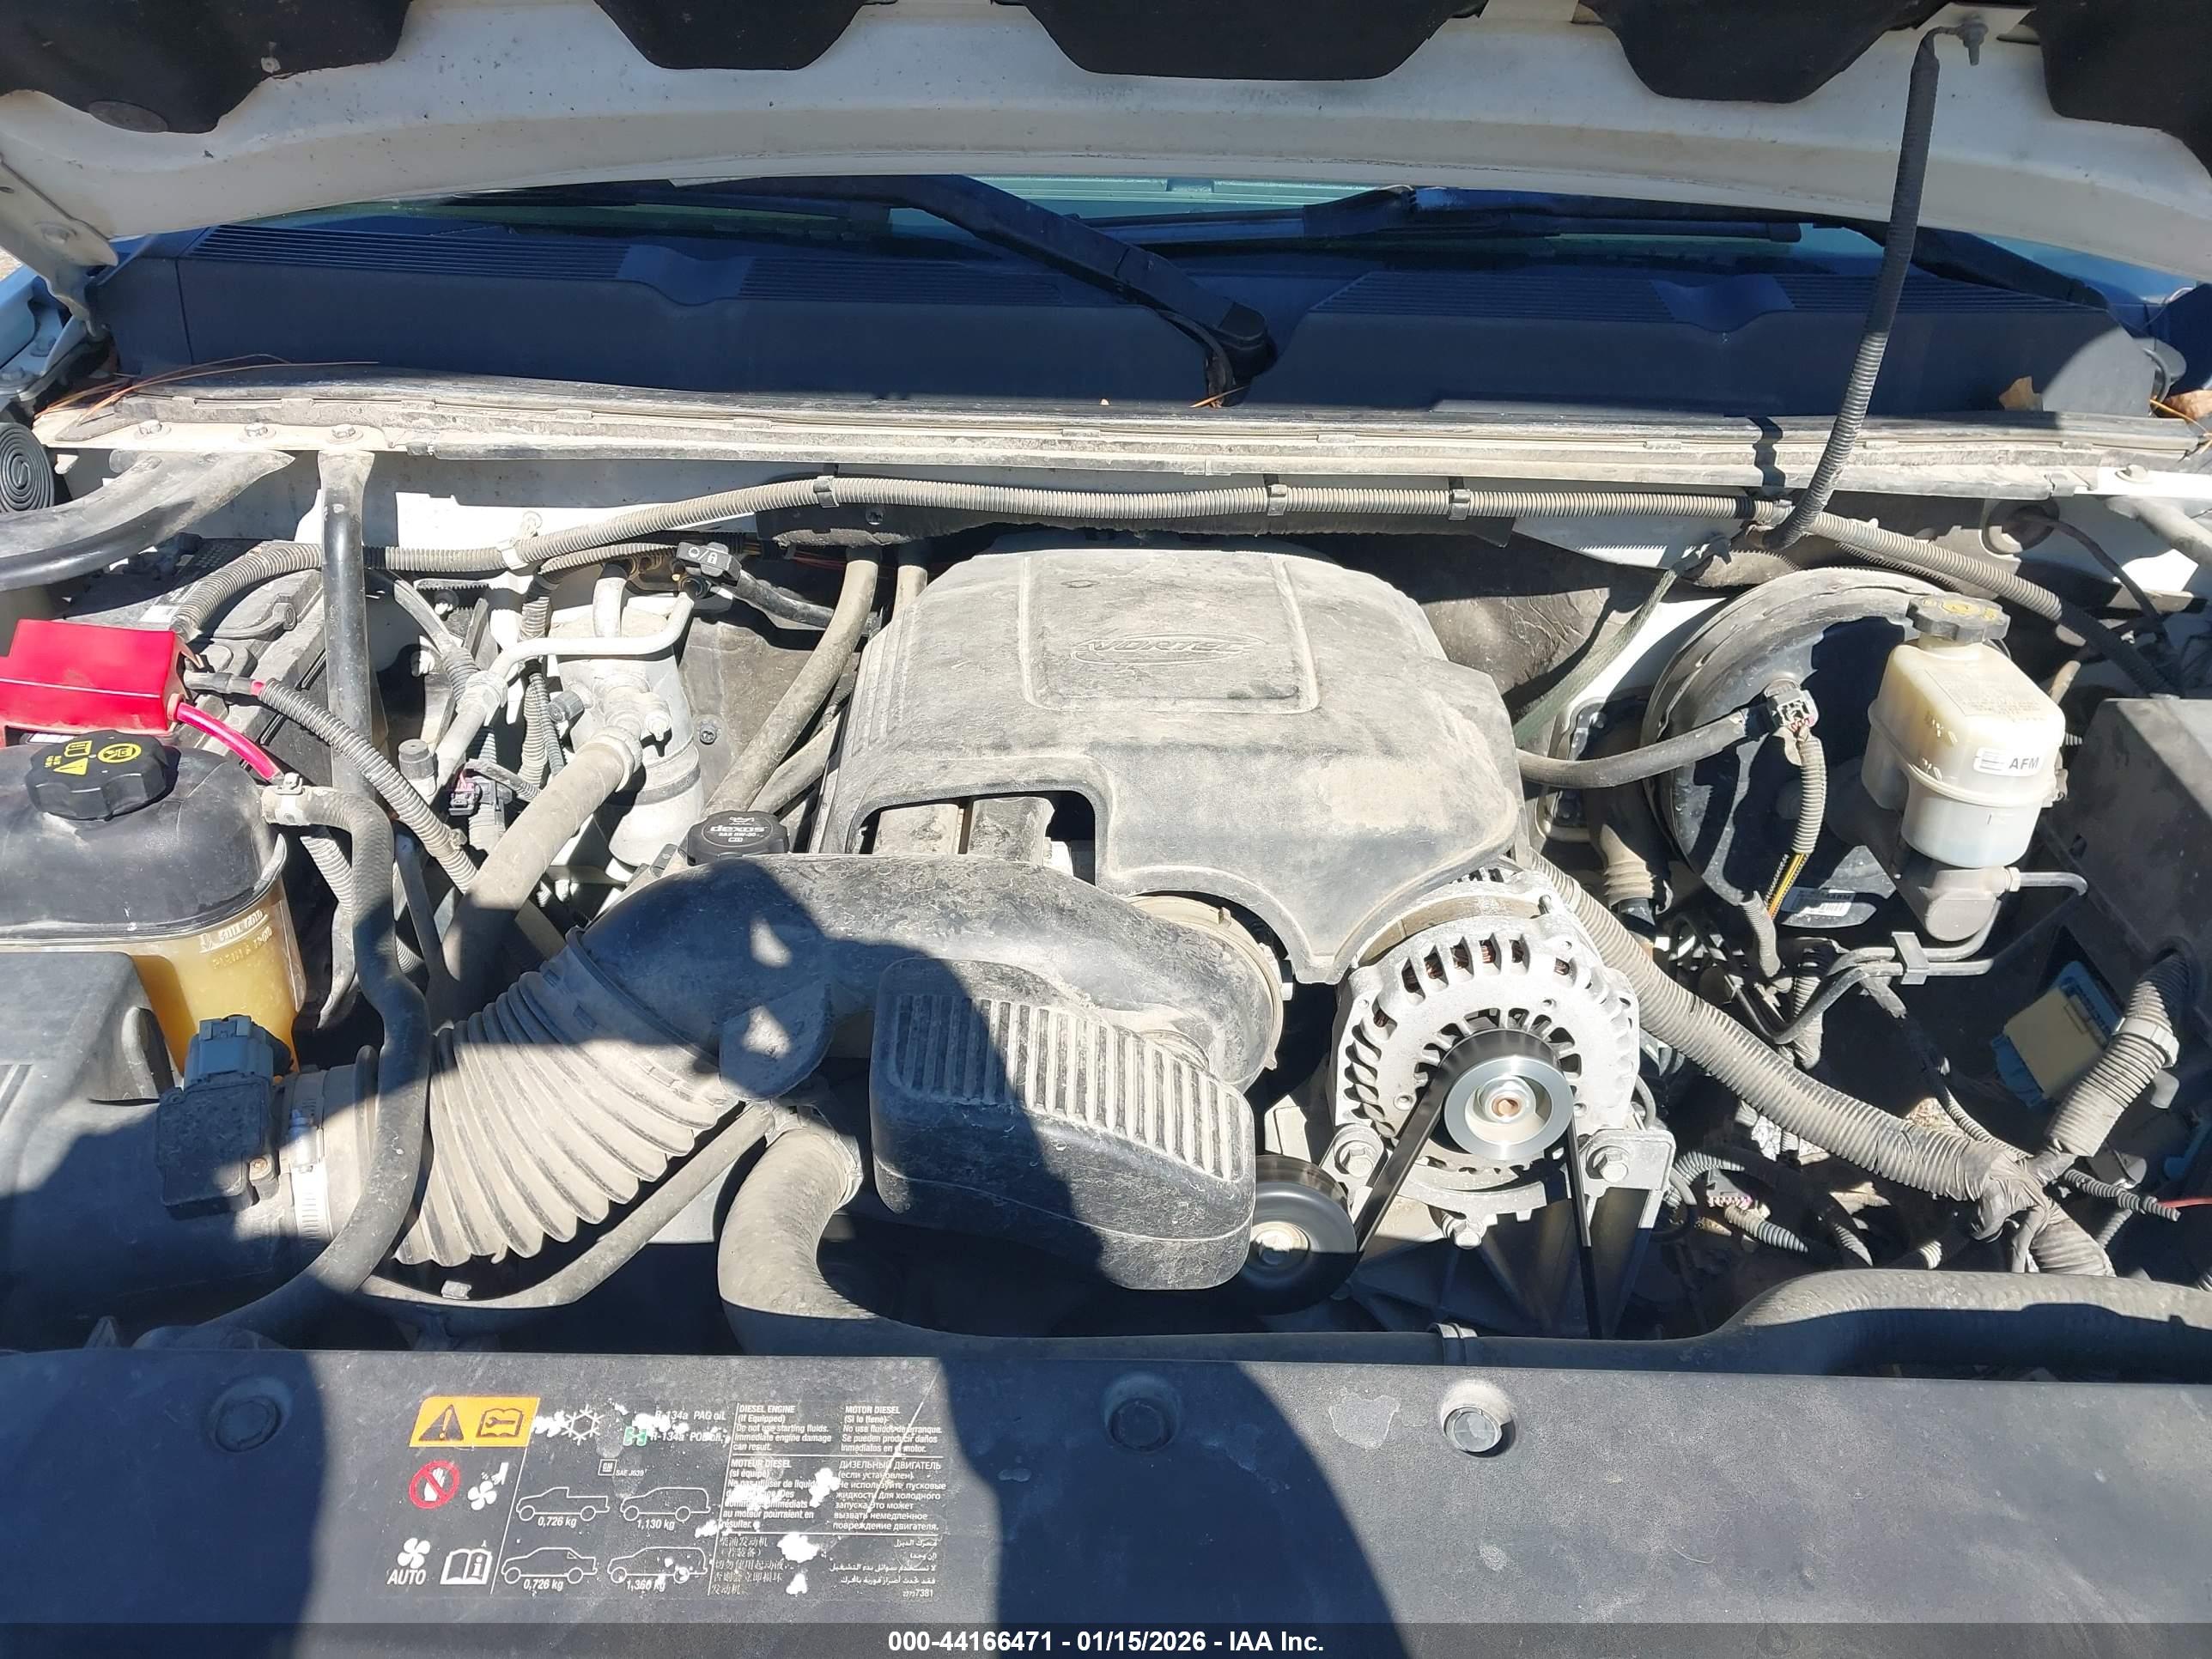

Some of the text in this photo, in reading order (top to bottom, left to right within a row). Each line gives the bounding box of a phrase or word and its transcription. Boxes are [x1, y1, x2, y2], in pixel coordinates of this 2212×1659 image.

[2008, 757, 2040, 770] AFM
[739, 1405, 796, 1413] DIESEL ENGINE
[845, 1406, 900, 1414] MOTOR DIESEL
[655, 1410, 689, 1420] R134a
[693, 1410, 712, 1420] PAG
[748, 1414, 786, 1424] Equipped)
[776, 1425, 805, 1434] starting
[807, 1424, 830, 1432] fluids.
[650, 1431, 684, 1442] R-134a
[735, 1433, 832, 1443] Immediate engine damage
[842, 1434, 852, 1443] Se
[854, 1434, 881, 1443] pueden
[915, 1434, 938, 1443] daños
[731, 1459, 792, 1468] MOTEUR DIESEL
[839, 1460, 941, 1470] ДИЗЕЛЬНЫЙ ДВИГАТЕЛЬ
[782, 1480, 793, 1488] de
[794, 1480, 819, 1490] liquid
[905, 1483, 946, 1492] пусковые
[878, 1492, 894, 1501] для
[870, 1512, 928, 1521] немедленное
[538, 1516, 577, 1528] 0,726 kg
[636, 1519, 675, 1531] 1,130 kg
[833, 1522, 939, 1531] повреждение двигателя.
[386, 1569, 427, 1585] AUTO
[523, 1578, 564, 1592] 0,726 kg
